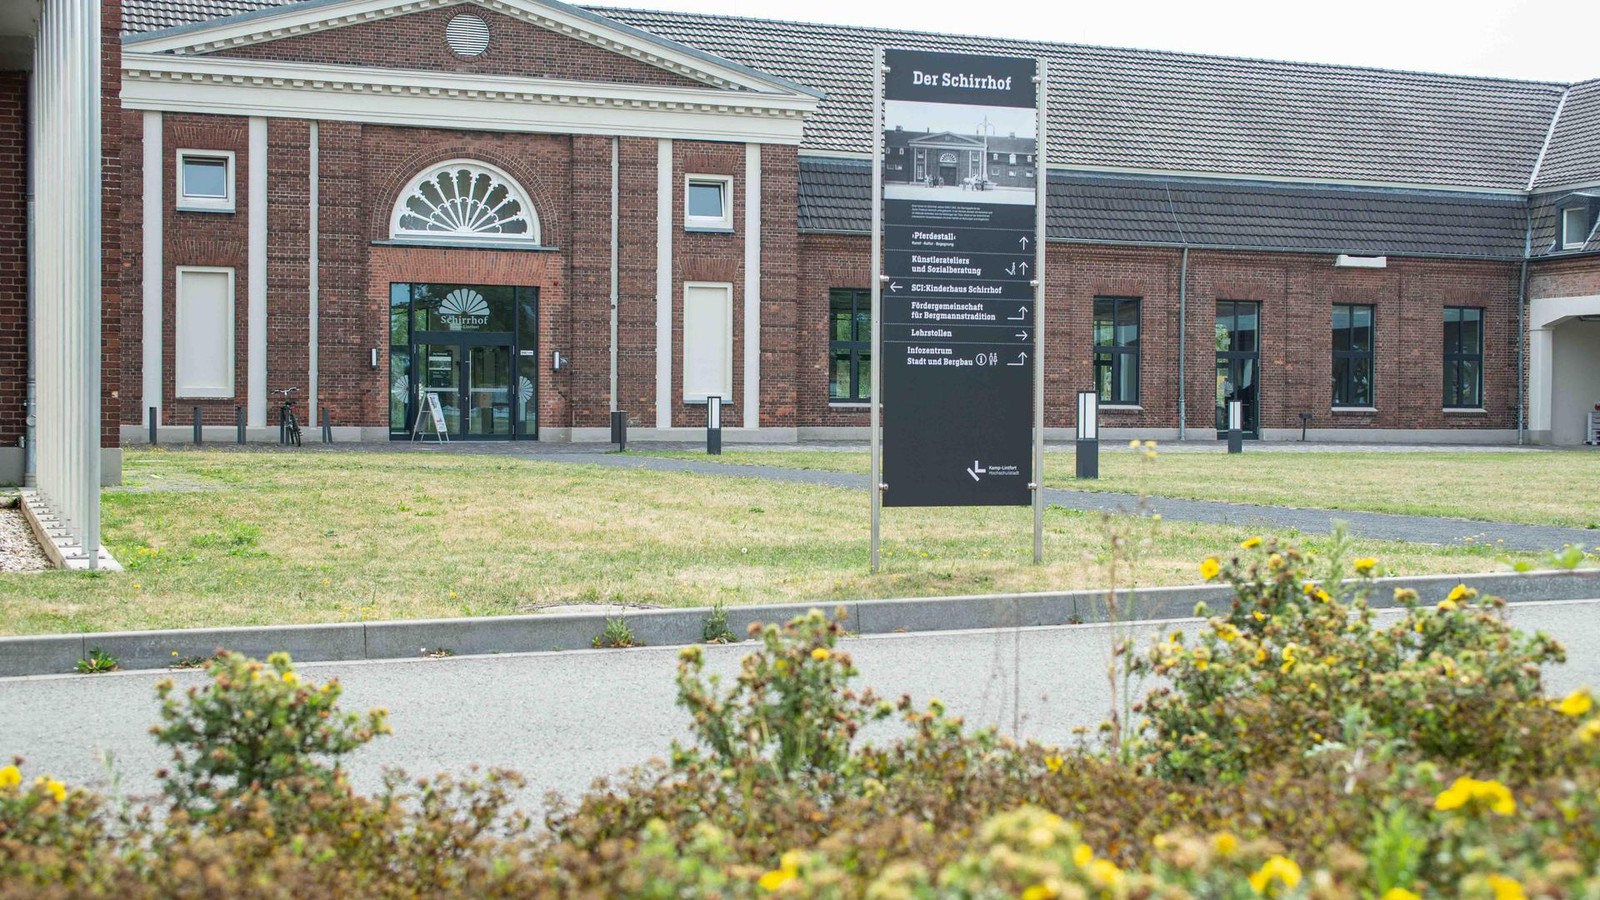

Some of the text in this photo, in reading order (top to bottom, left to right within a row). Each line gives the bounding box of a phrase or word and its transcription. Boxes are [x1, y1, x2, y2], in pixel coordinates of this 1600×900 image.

[913, 71, 1012, 90] Der Schirrhof
[911, 255, 970, 265] Künstlerateliers
[911, 265, 982, 276] und Sozialberatung
[911, 284, 1003, 294] SCI:Kinderhaus Schirrhof
[911, 301, 984, 312] Fördergemeinschaft
[440, 315, 489, 325] Schirrhof
[911, 311, 996, 321] für Bergmannstradition
[911, 328, 953, 337] Lehrstollen
[907, 346, 953, 355] Infozentrum
[907, 357, 973, 367] Stadt und Bergbau
